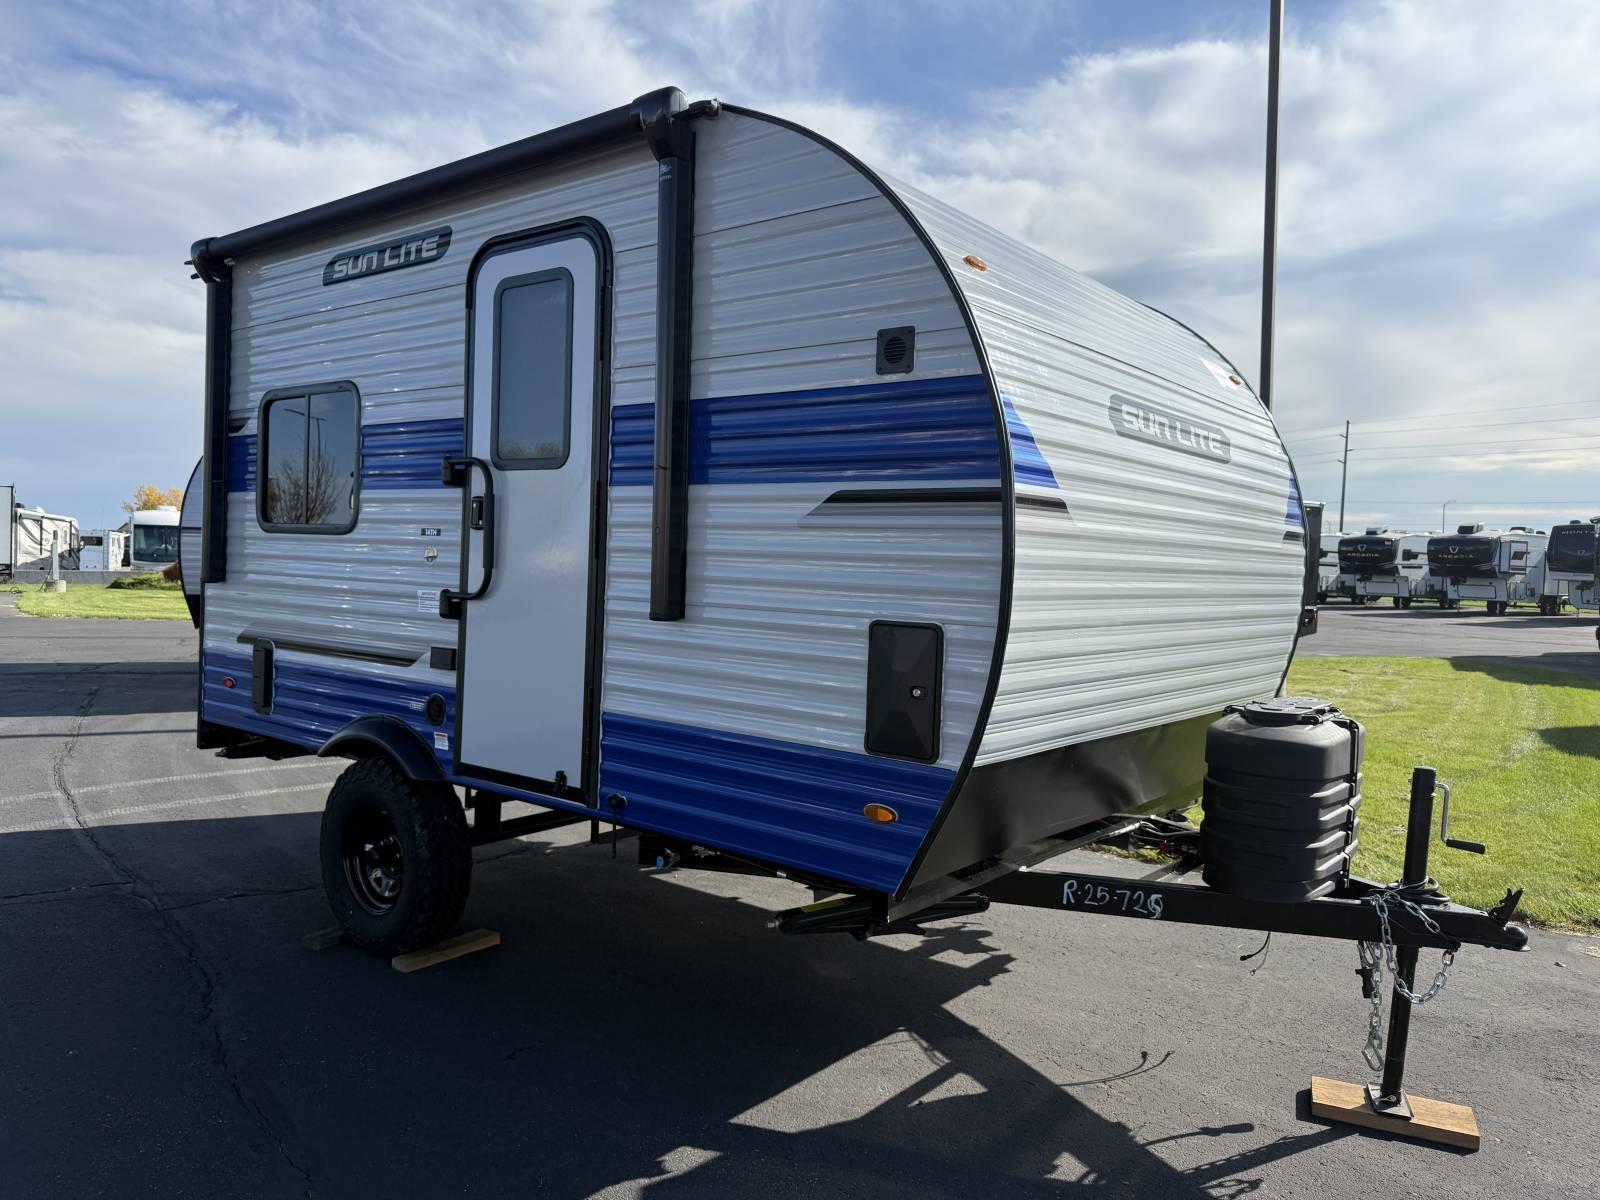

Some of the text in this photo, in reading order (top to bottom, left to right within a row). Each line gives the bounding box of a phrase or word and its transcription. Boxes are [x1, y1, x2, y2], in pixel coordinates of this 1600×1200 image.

[333, 235, 440, 279] SUN LITE
[1120, 404, 1223, 455] SUN LITE
